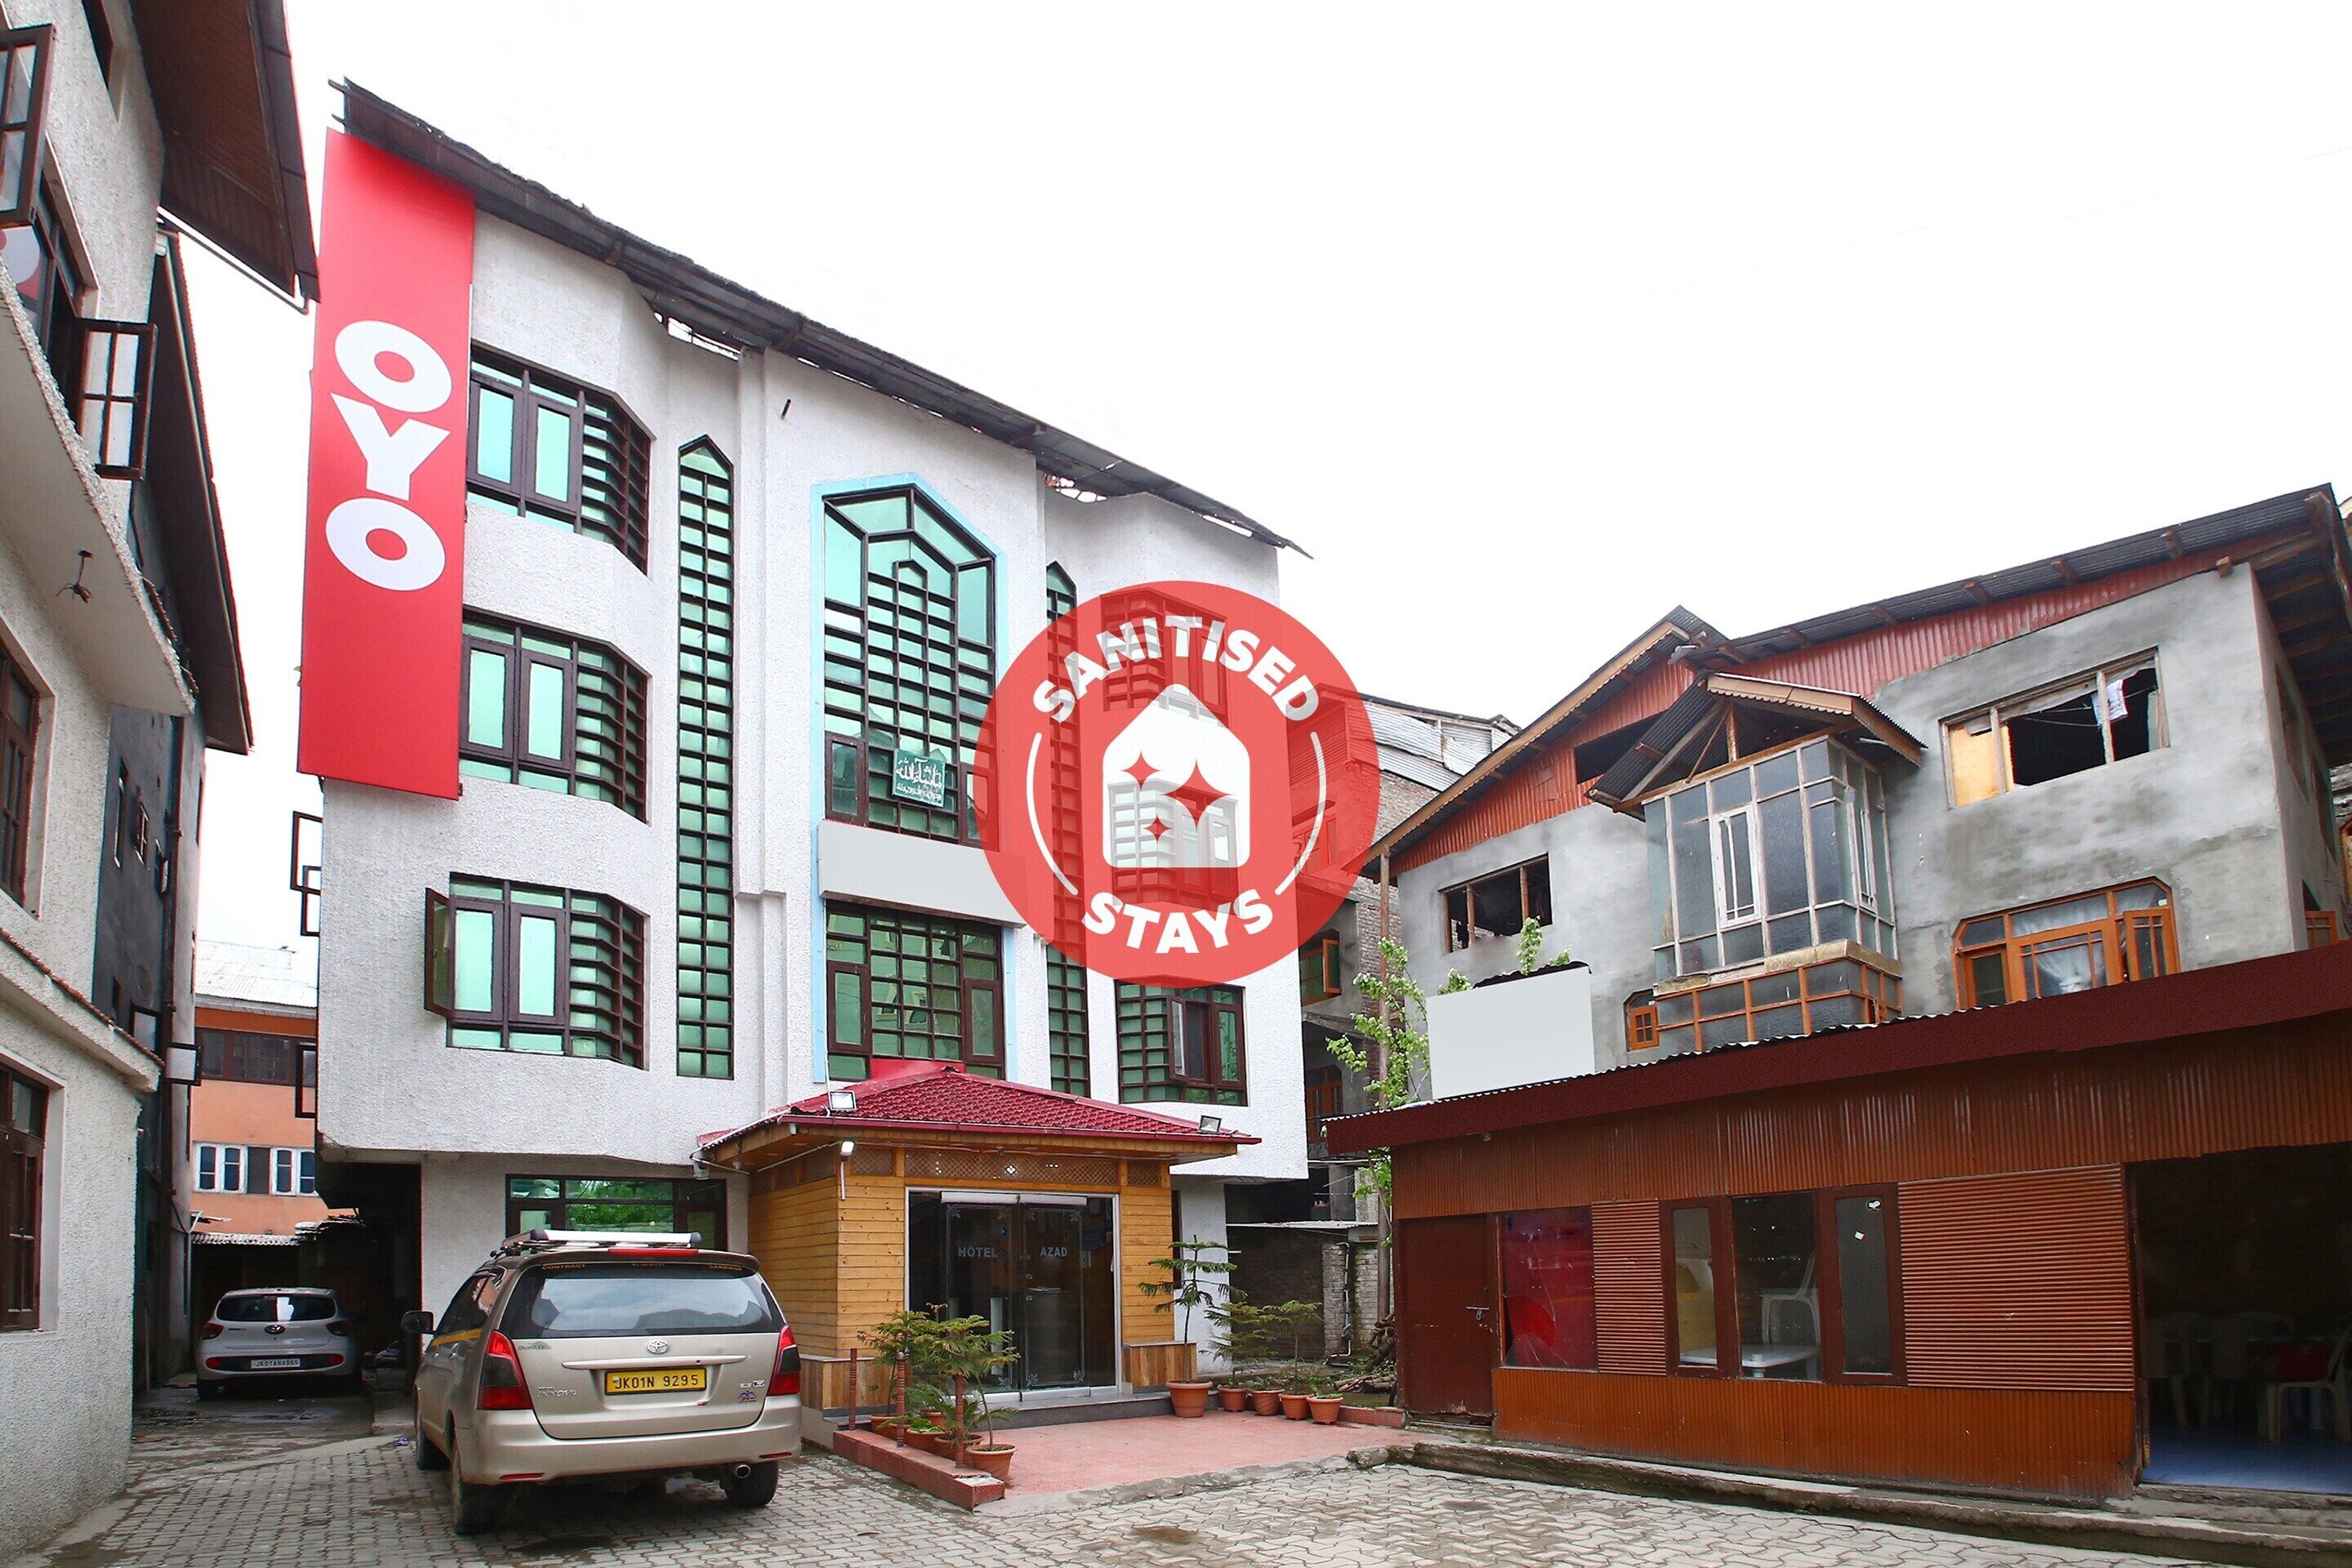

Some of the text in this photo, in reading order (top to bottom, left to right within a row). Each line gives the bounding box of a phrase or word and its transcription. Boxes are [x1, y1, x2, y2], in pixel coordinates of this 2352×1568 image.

[326, 320, 452, 591] OYO
[957, 1246, 1068, 1258] HOTEL AZAD
[614, 1374, 699, 1389] JK01N 9295
